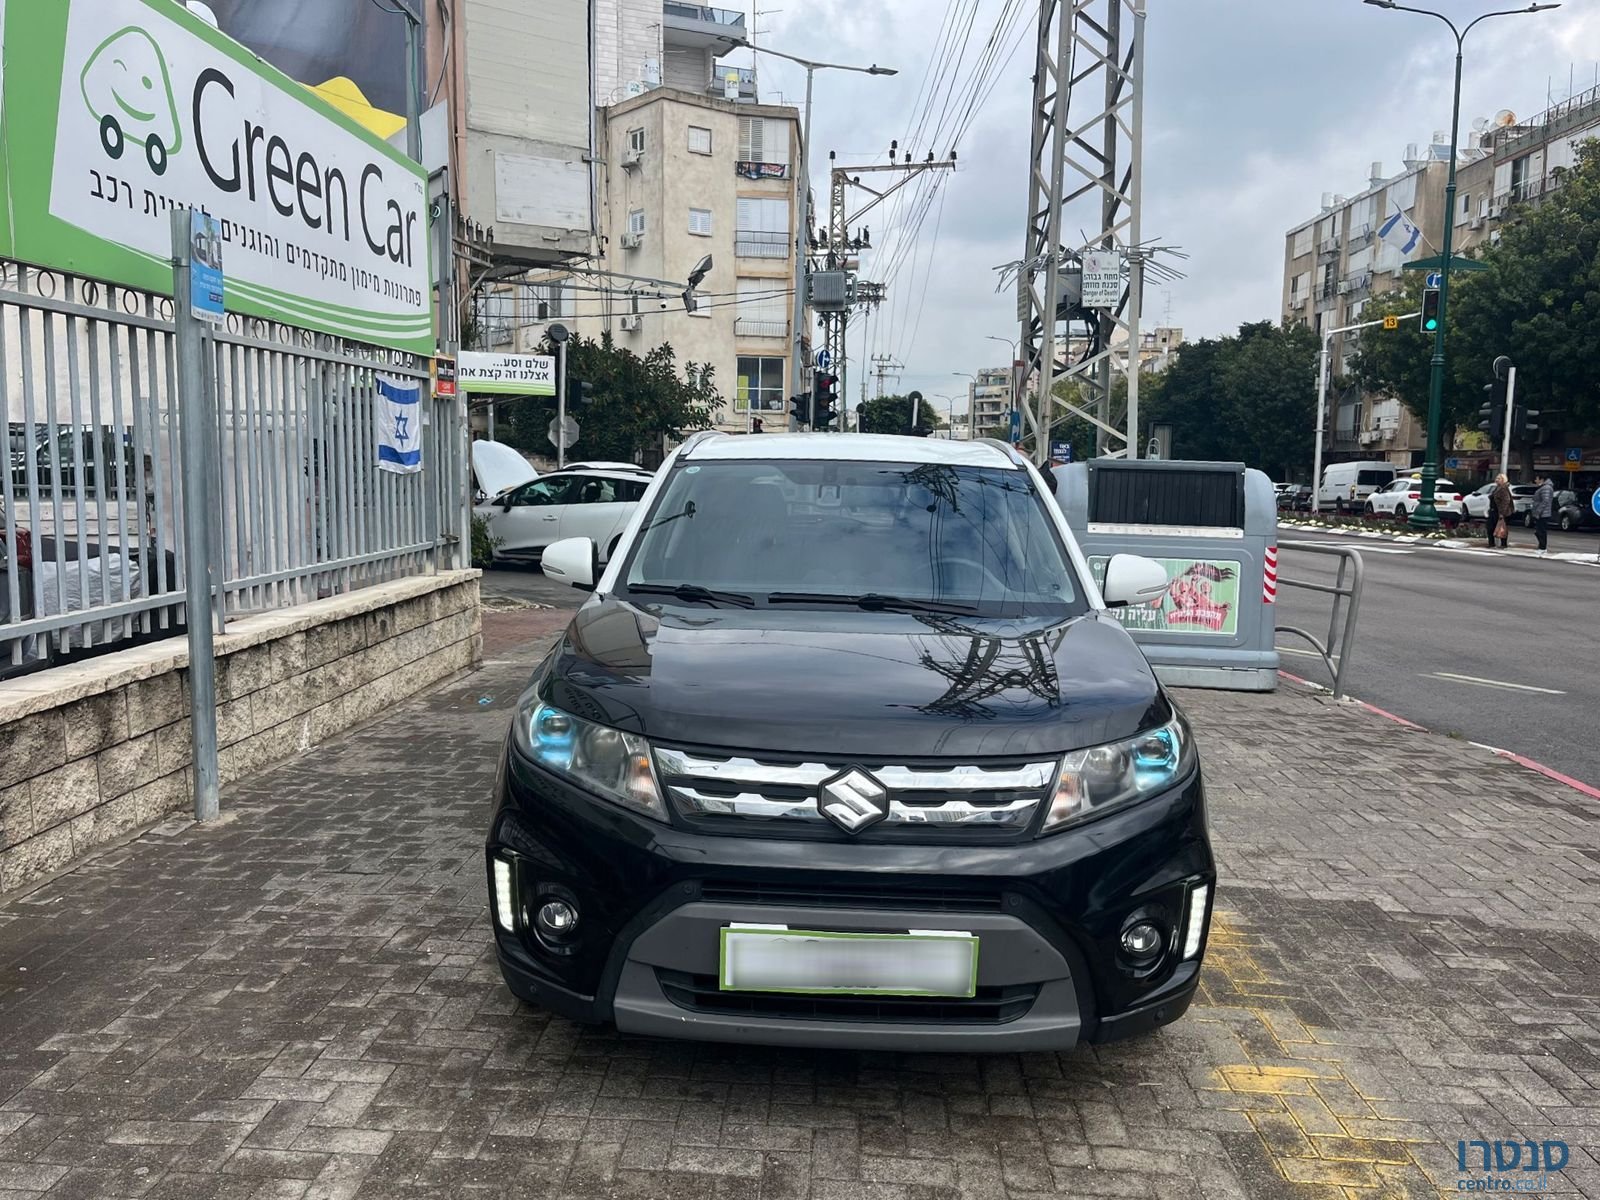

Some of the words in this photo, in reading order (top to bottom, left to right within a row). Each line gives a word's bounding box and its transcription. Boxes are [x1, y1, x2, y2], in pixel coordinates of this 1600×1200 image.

[192, 67, 350, 241] Green
[360, 163, 417, 268] Car
[90, 169, 133, 209] רכב
[221, 218, 279, 260] והוגנים
[286, 242, 346, 282] מתקדמים
[351, 266, 380, 293] מימון
[383, 278, 421, 307] פתרונות
[1386, 318, 1396, 327] 13
[479, 368, 502, 380] קצת
[525, 358, 549, 369] שלם
[505, 370, 517, 379] זה
[519, 369, 549, 381] אצלנו
[1127, 607, 1157, 622] עליה
